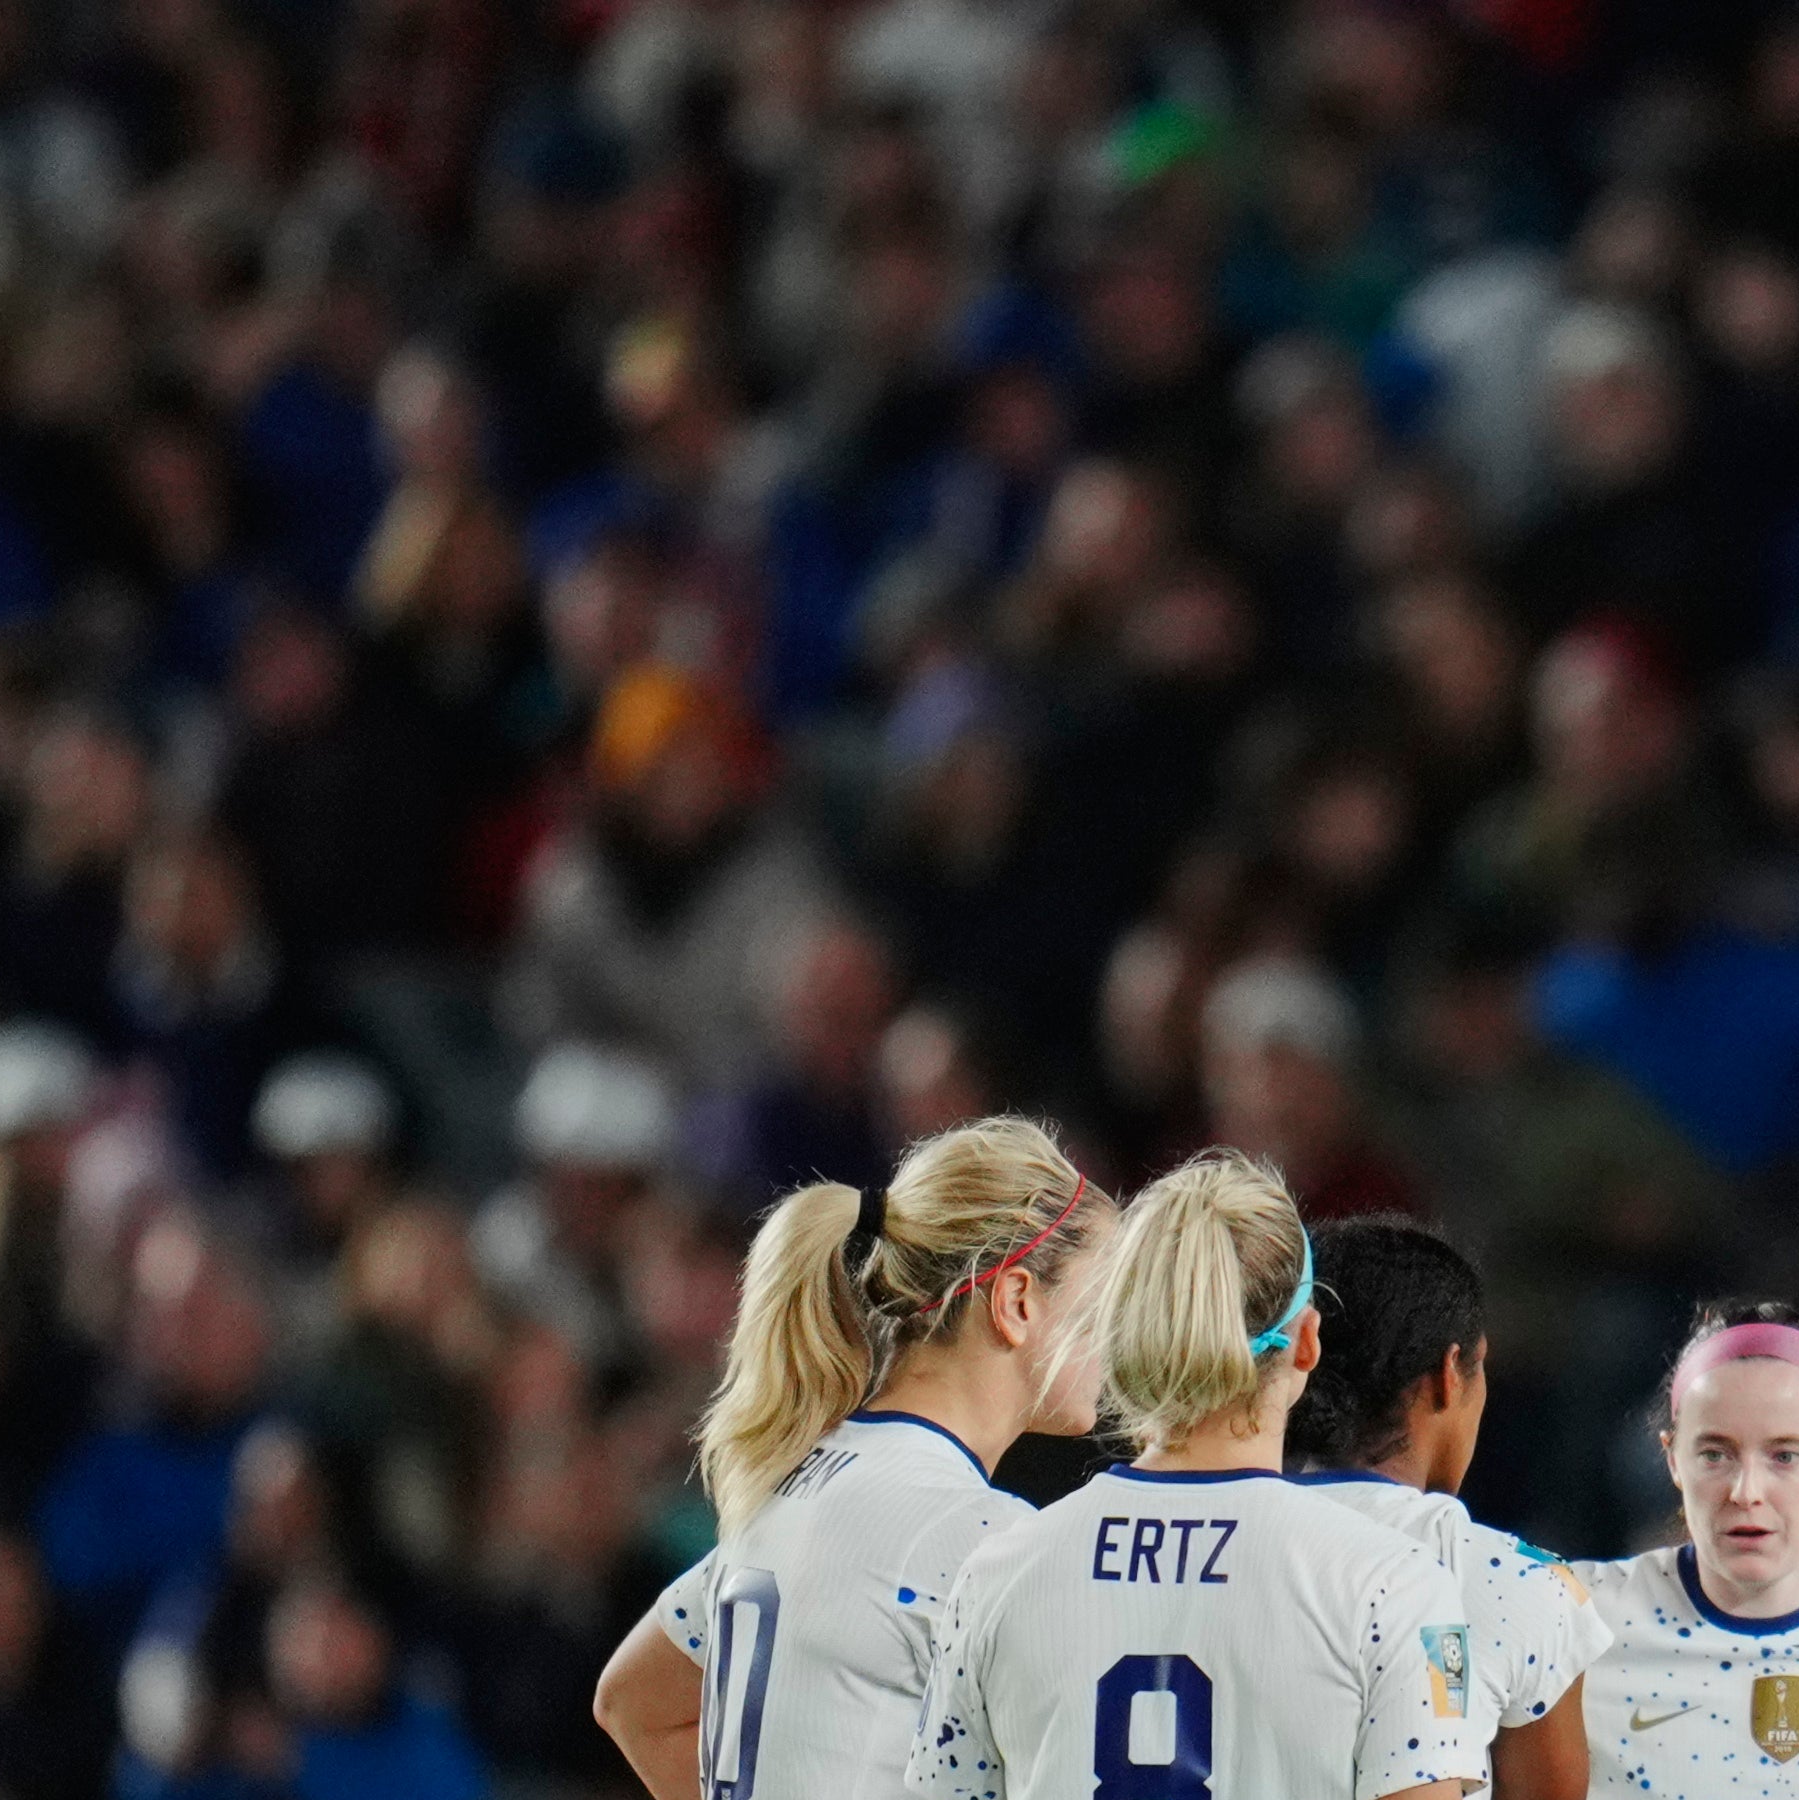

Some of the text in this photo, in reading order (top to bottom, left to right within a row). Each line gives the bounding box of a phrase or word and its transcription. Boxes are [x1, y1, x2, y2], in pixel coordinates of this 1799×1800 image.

[772, 1446, 860, 1500] RAN
[1092, 1516, 1238, 1585] ERTZ
[1767, 1730, 1799, 1742] FIFA
